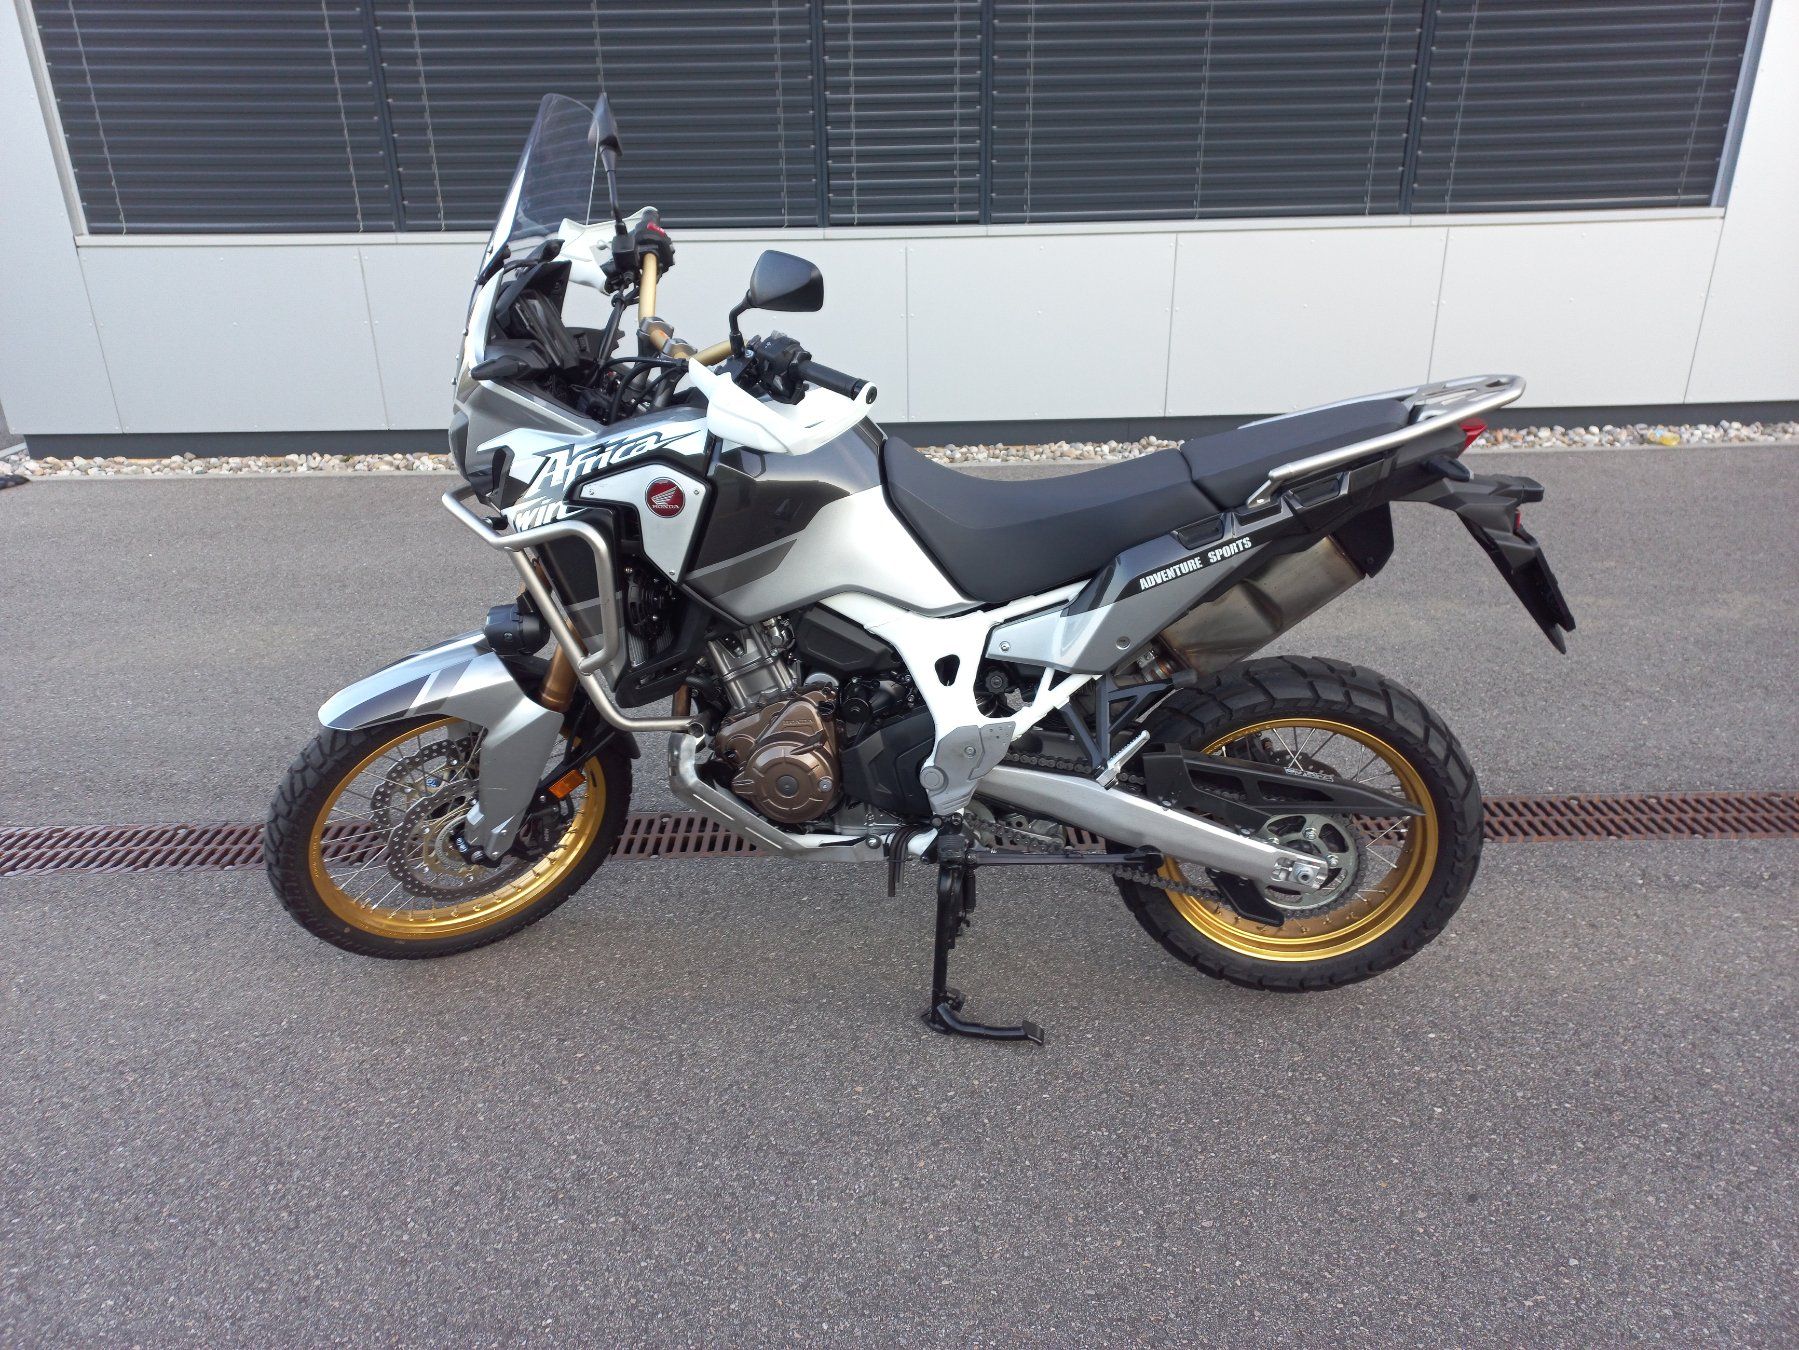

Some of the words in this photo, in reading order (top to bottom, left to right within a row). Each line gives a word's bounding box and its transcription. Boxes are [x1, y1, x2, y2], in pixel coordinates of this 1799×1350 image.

[522, 430, 700, 499] Africa
[1139, 556, 1203, 591] ADVENTURE
[1207, 536, 1252, 564] SPORTS
